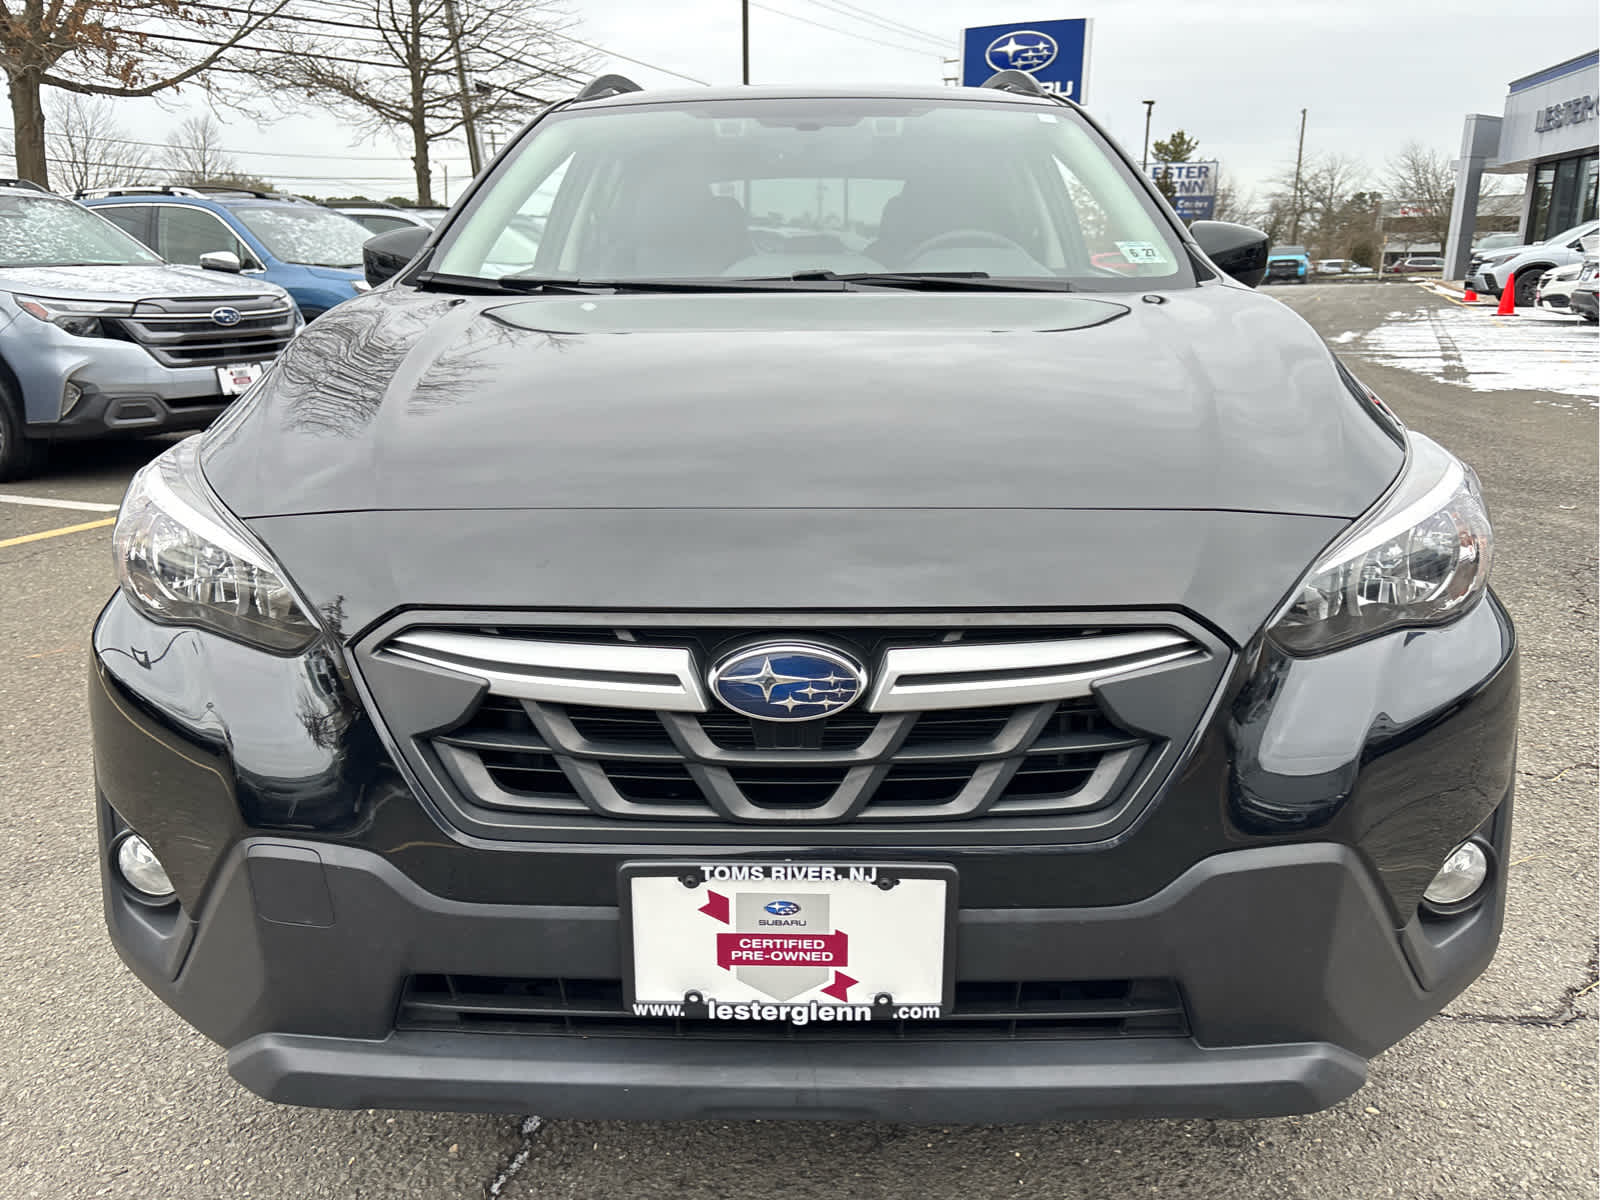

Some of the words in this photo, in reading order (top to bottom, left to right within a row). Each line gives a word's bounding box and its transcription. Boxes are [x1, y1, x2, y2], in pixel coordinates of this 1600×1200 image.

[1151, 165, 1209, 179] ESTER
[700, 866, 764, 881] TOMS
[849, 867, 877, 882] NJ
[758, 919, 807, 927] SUBARU
[739, 938, 825, 949] CERTIFIED
[731, 951, 834, 962] PRE-OWNED
[632, 1003, 685, 1017] www.
[708, 1000, 871, 1026] lesterglenn
[892, 1005, 940, 1019] .com
